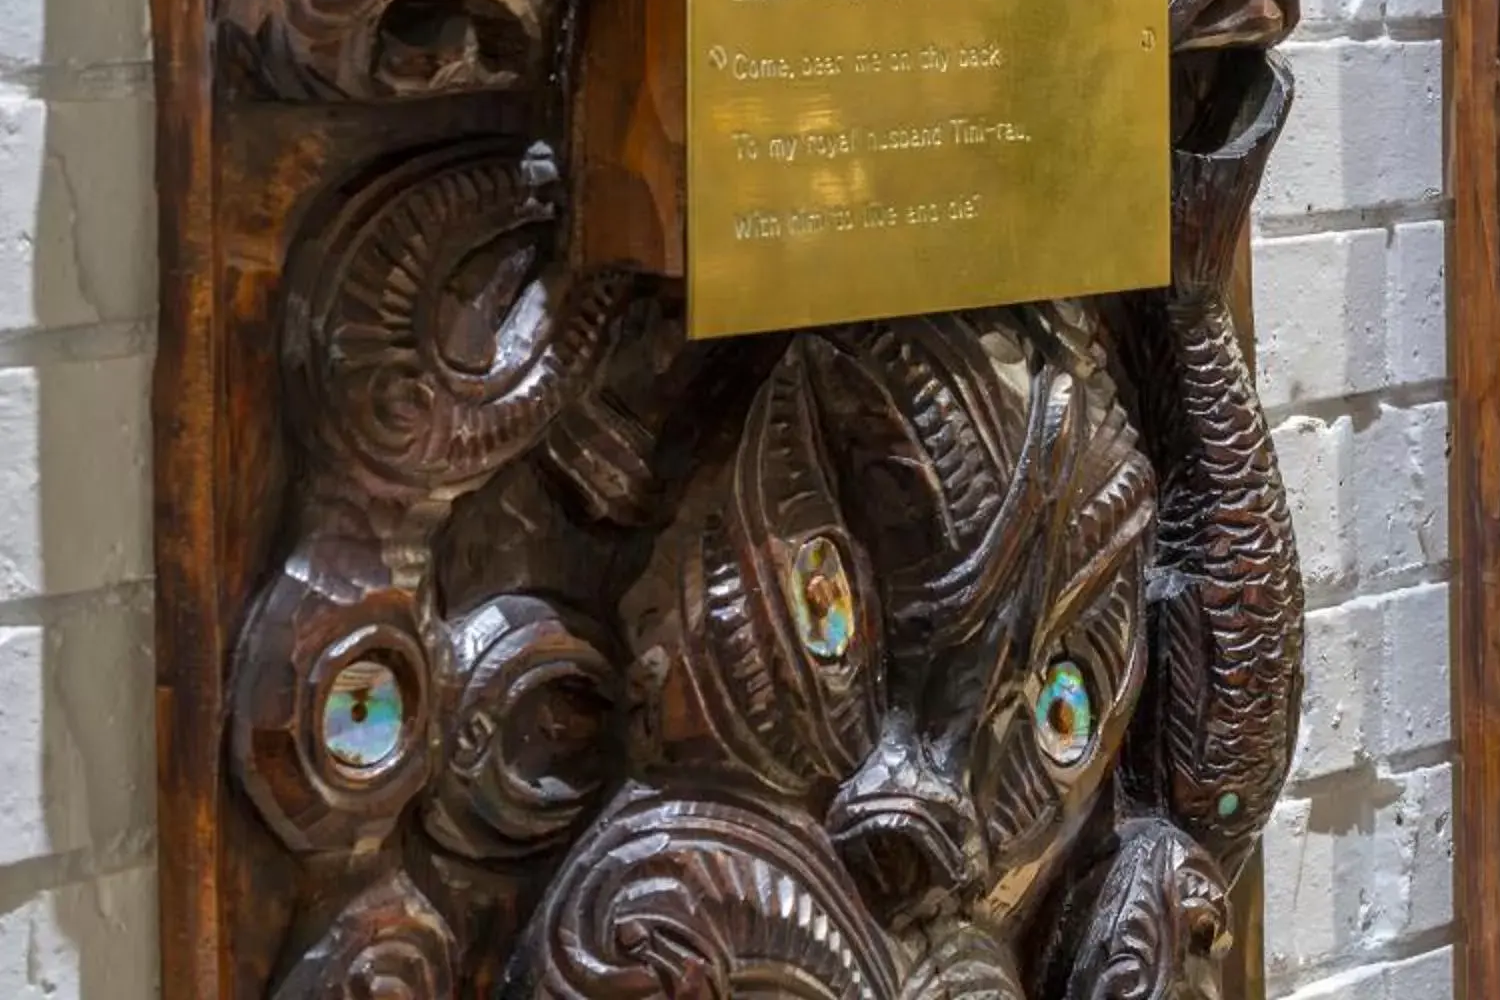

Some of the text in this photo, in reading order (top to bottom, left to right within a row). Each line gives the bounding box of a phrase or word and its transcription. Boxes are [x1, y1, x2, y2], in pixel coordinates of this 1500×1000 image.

[854, 53, 882, 73] me
[889, 52, 912, 72] on
[730, 131, 759, 160] To
[768, 138, 798, 162] my
